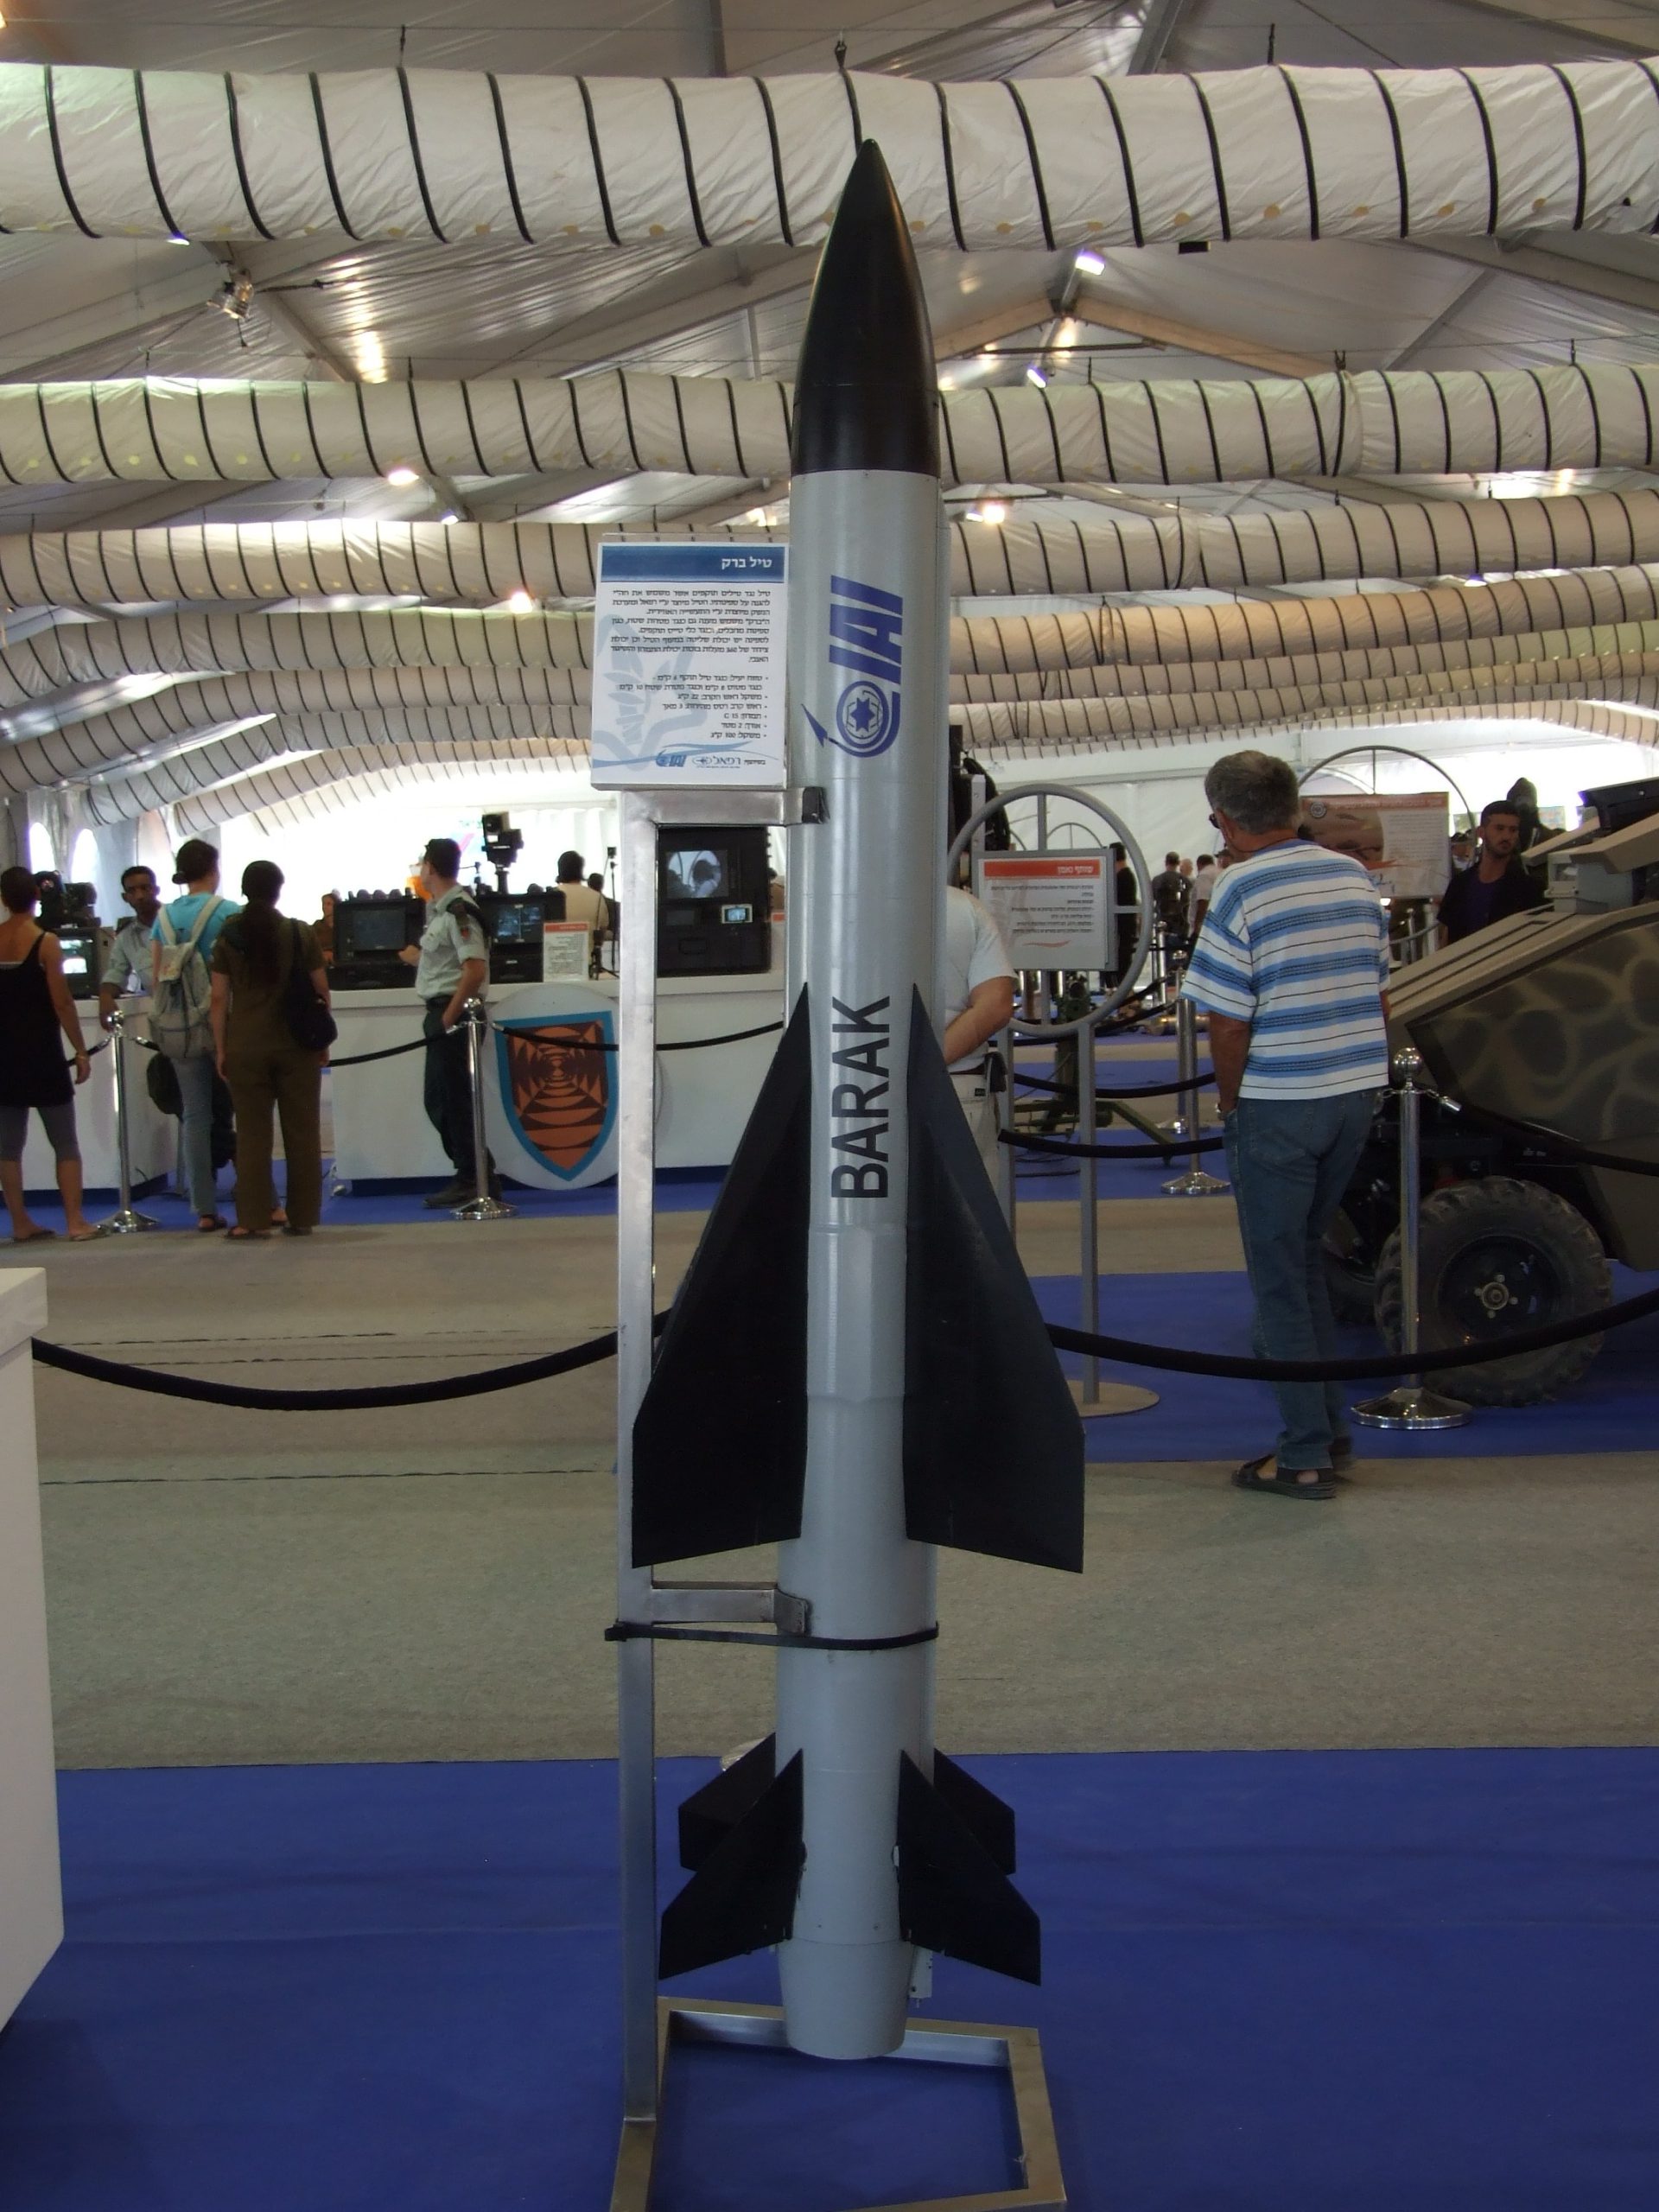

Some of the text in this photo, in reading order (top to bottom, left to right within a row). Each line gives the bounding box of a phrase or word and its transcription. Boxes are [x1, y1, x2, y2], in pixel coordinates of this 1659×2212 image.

[721, 556, 772, 570] טיל ברק
[829, 575, 903, 685] IAI
[740, 692, 762, 701] משקל
[712, 755, 741, 766] רפאל
[831, 995, 890, 1198] BARAK
